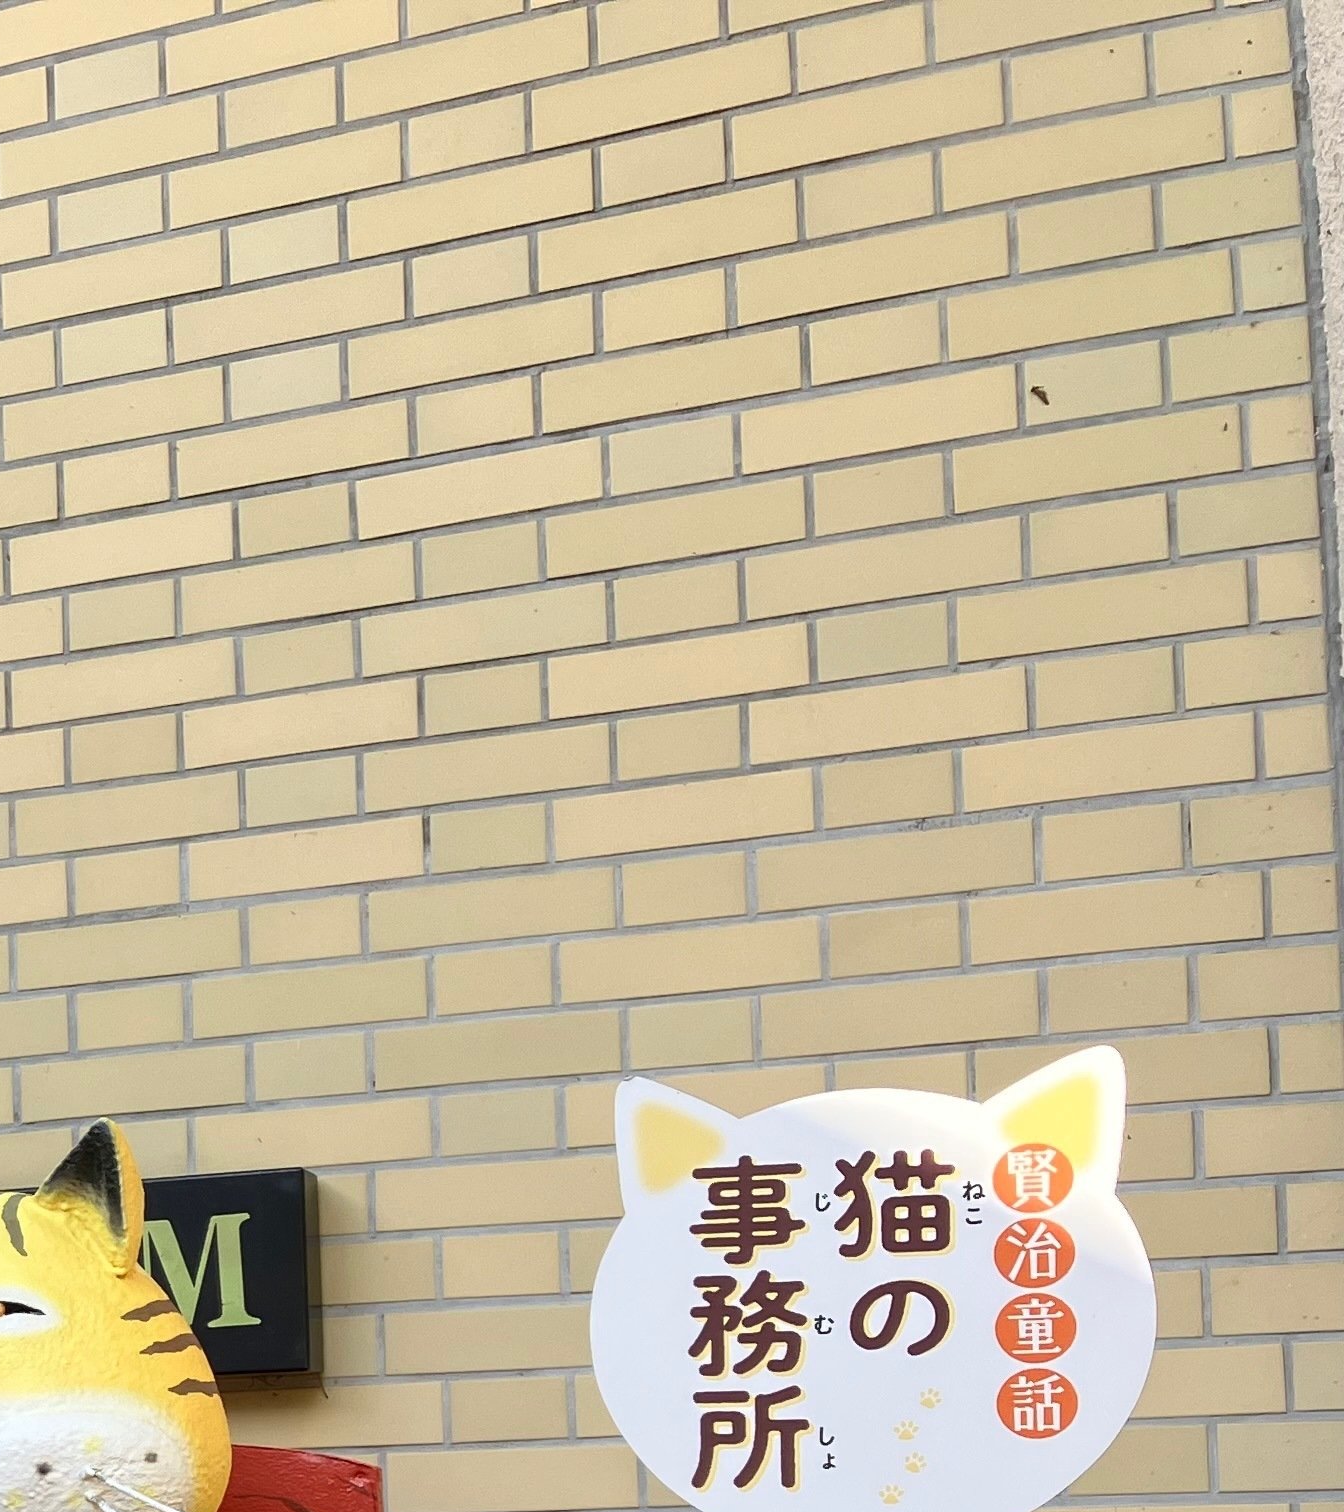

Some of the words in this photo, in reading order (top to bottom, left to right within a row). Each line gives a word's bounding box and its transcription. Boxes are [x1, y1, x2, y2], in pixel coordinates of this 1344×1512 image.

[687, 1155, 810, 1490] 事務所
[833, 1149, 955, 1356] 猫の
[962, 1180, 986, 1225] ねこ
[1006, 1147, 1066, 1432] 賢治童話
